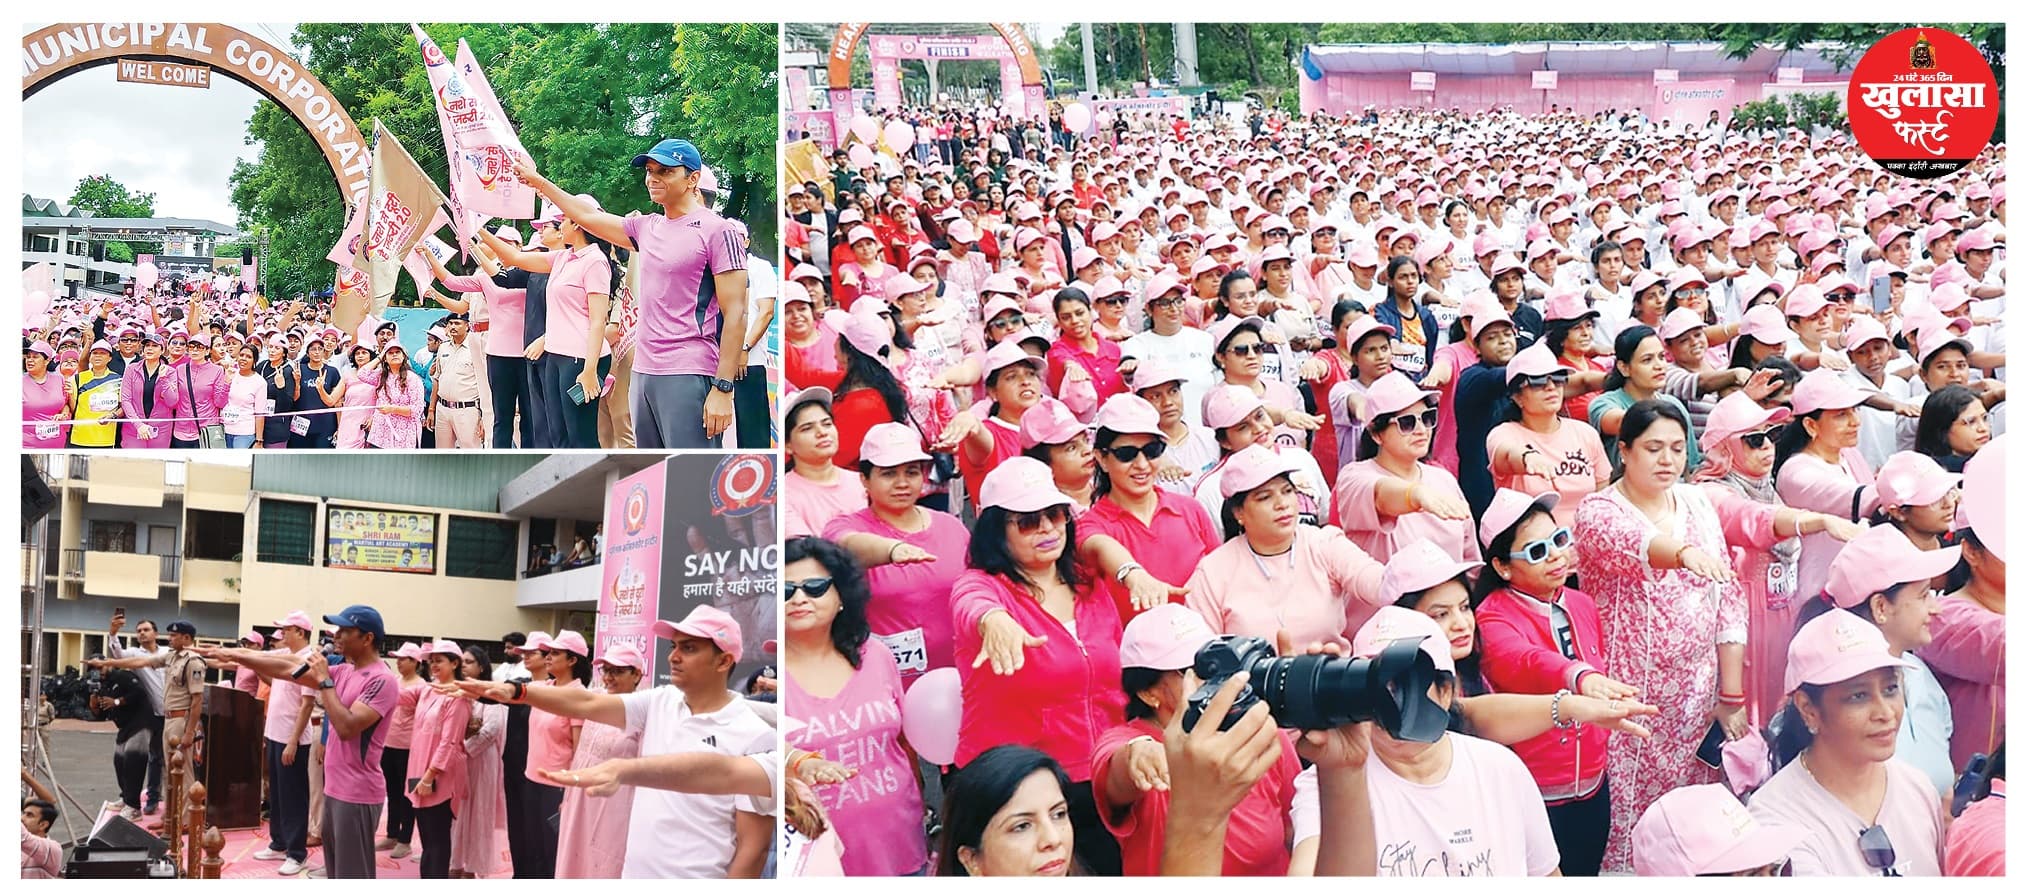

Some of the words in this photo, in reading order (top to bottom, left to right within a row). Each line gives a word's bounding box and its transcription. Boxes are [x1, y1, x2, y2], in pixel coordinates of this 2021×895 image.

[121, 62, 156, 80] WEL
[162, 66, 207, 84] COME
[363, 531, 381, 539] SHRI
[384, 532, 400, 540] RAM
[684, 551, 731, 577] SAY
[740, 544, 777, 572] NO
[683, 583, 713, 598] हमारा
[716, 576, 724, 597] है
[727, 576, 751, 596] यही
[754, 574, 777, 594] संदे
[794, 698, 899, 745] ALVIN
[812, 766, 899, 812] EANS
